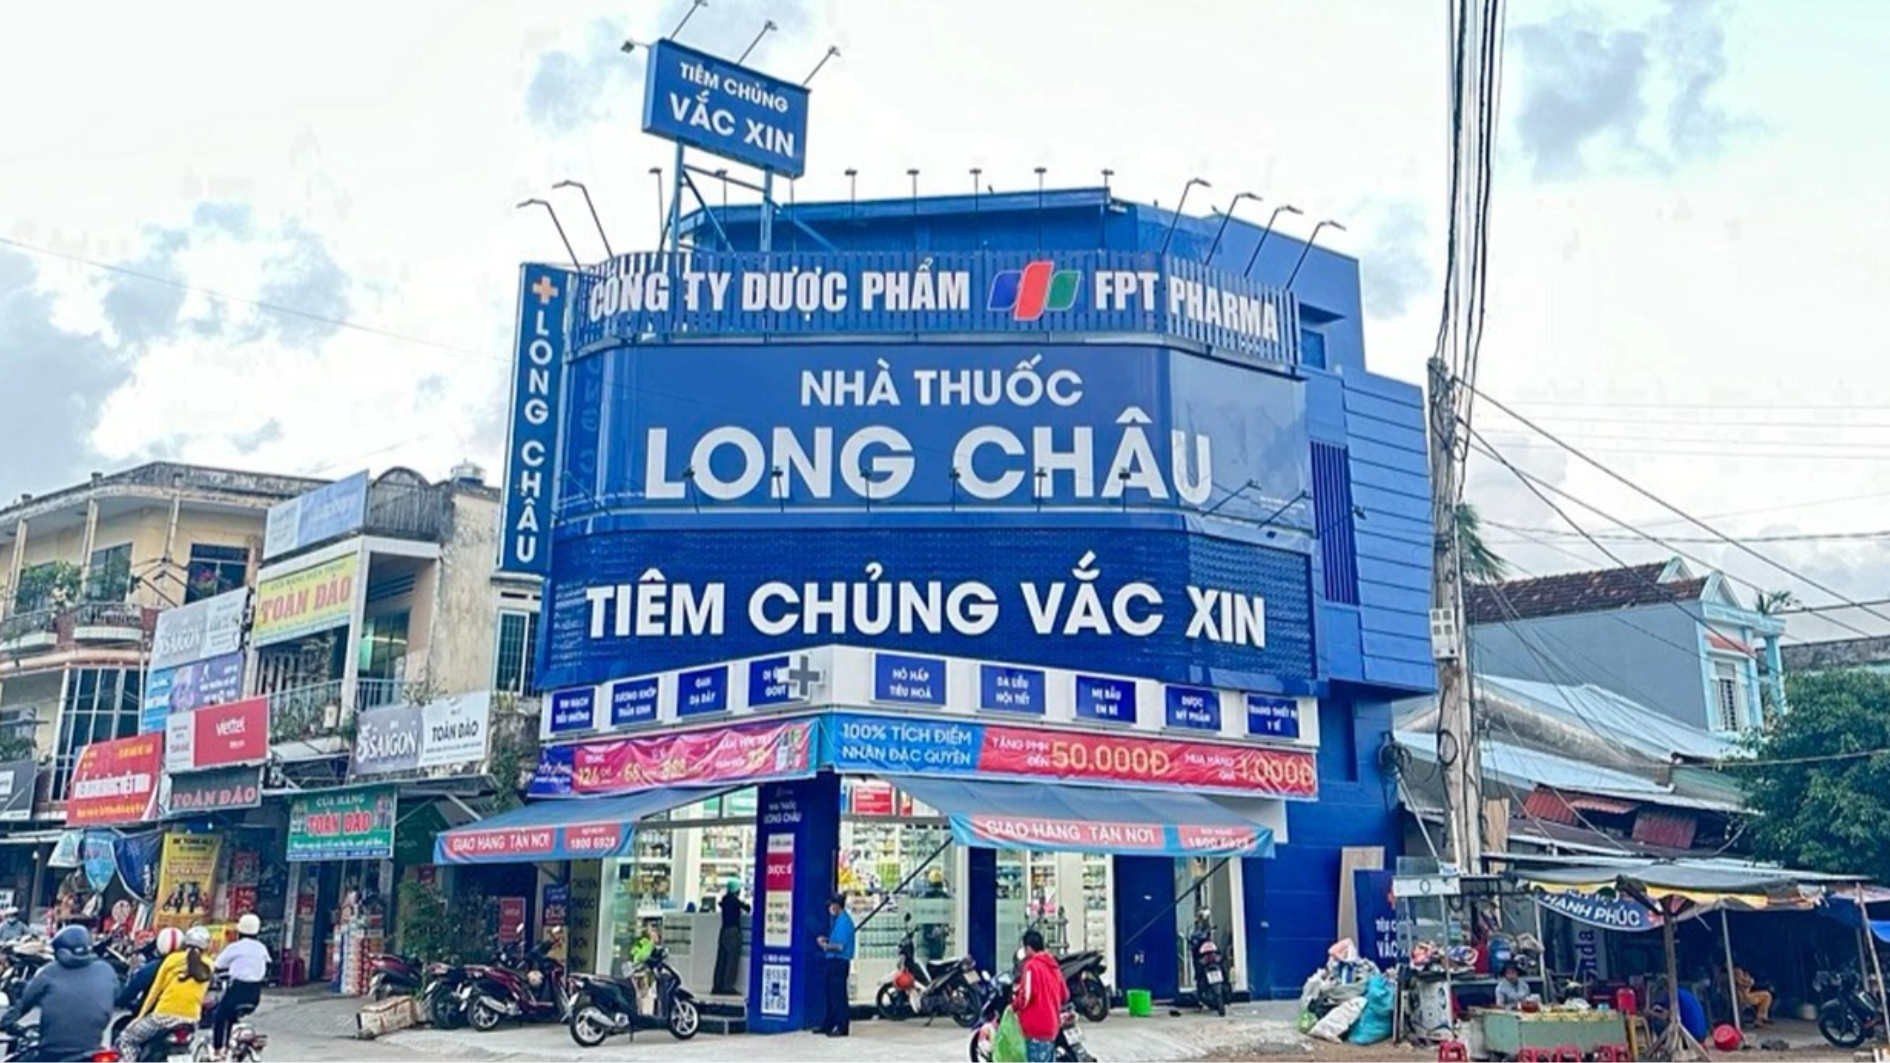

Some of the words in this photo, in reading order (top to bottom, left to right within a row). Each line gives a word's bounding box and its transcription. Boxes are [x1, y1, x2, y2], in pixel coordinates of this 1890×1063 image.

[680, 62, 718, 90] TIÊM
[670, 90, 735, 136] VẮC
[744, 118, 794, 157] XIN
[590, 266, 669, 323] CÔNG
[684, 272, 734, 311] TY
[743, 266, 847, 321] DƯỢC
[862, 258, 970, 311] PHẨM
[1095, 271, 1159, 311] FPT
[1170, 275, 1279, 342] PHARMA
[524, 311, 553, 425] LONG
[801, 358, 900, 407] NHÀ
[914, 354, 1083, 406] THUỐC
[646, 425, 915, 499] LONG
[953, 406, 1211, 505] CHÂU
[516, 441, 546, 562] CHÂU
[586, 568, 725, 638] TIÊM
[748, 562, 998, 635] CHỦNG
[1020, 550, 1163, 636] VẮC
[1185, 585, 1265, 648] XIN
[842, 722, 886, 741] 100%
[891, 722, 931, 742] TÍCH
[934, 726, 972, 744] ĐIỂM
[841, 744, 886, 762] NHÂN
[1053, 741, 1170, 775] 50.000Đ
[1185, 753, 1205, 764] MUA
[453, 836, 475, 851] GIAO
[478, 833, 505, 850] HÀNG
[510, 828, 530, 851] TẬN
[531, 832, 549, 847] NƠI
[571, 837, 591, 849] 1800
[985, 819, 1029, 838] GIAO
[1032, 822, 1081, 841] HÀNG
[1088, 824, 1122, 845] TẬN
[1126, 826, 1155, 844] NƠI
[1594, 905, 1640, 926] PHÚC
